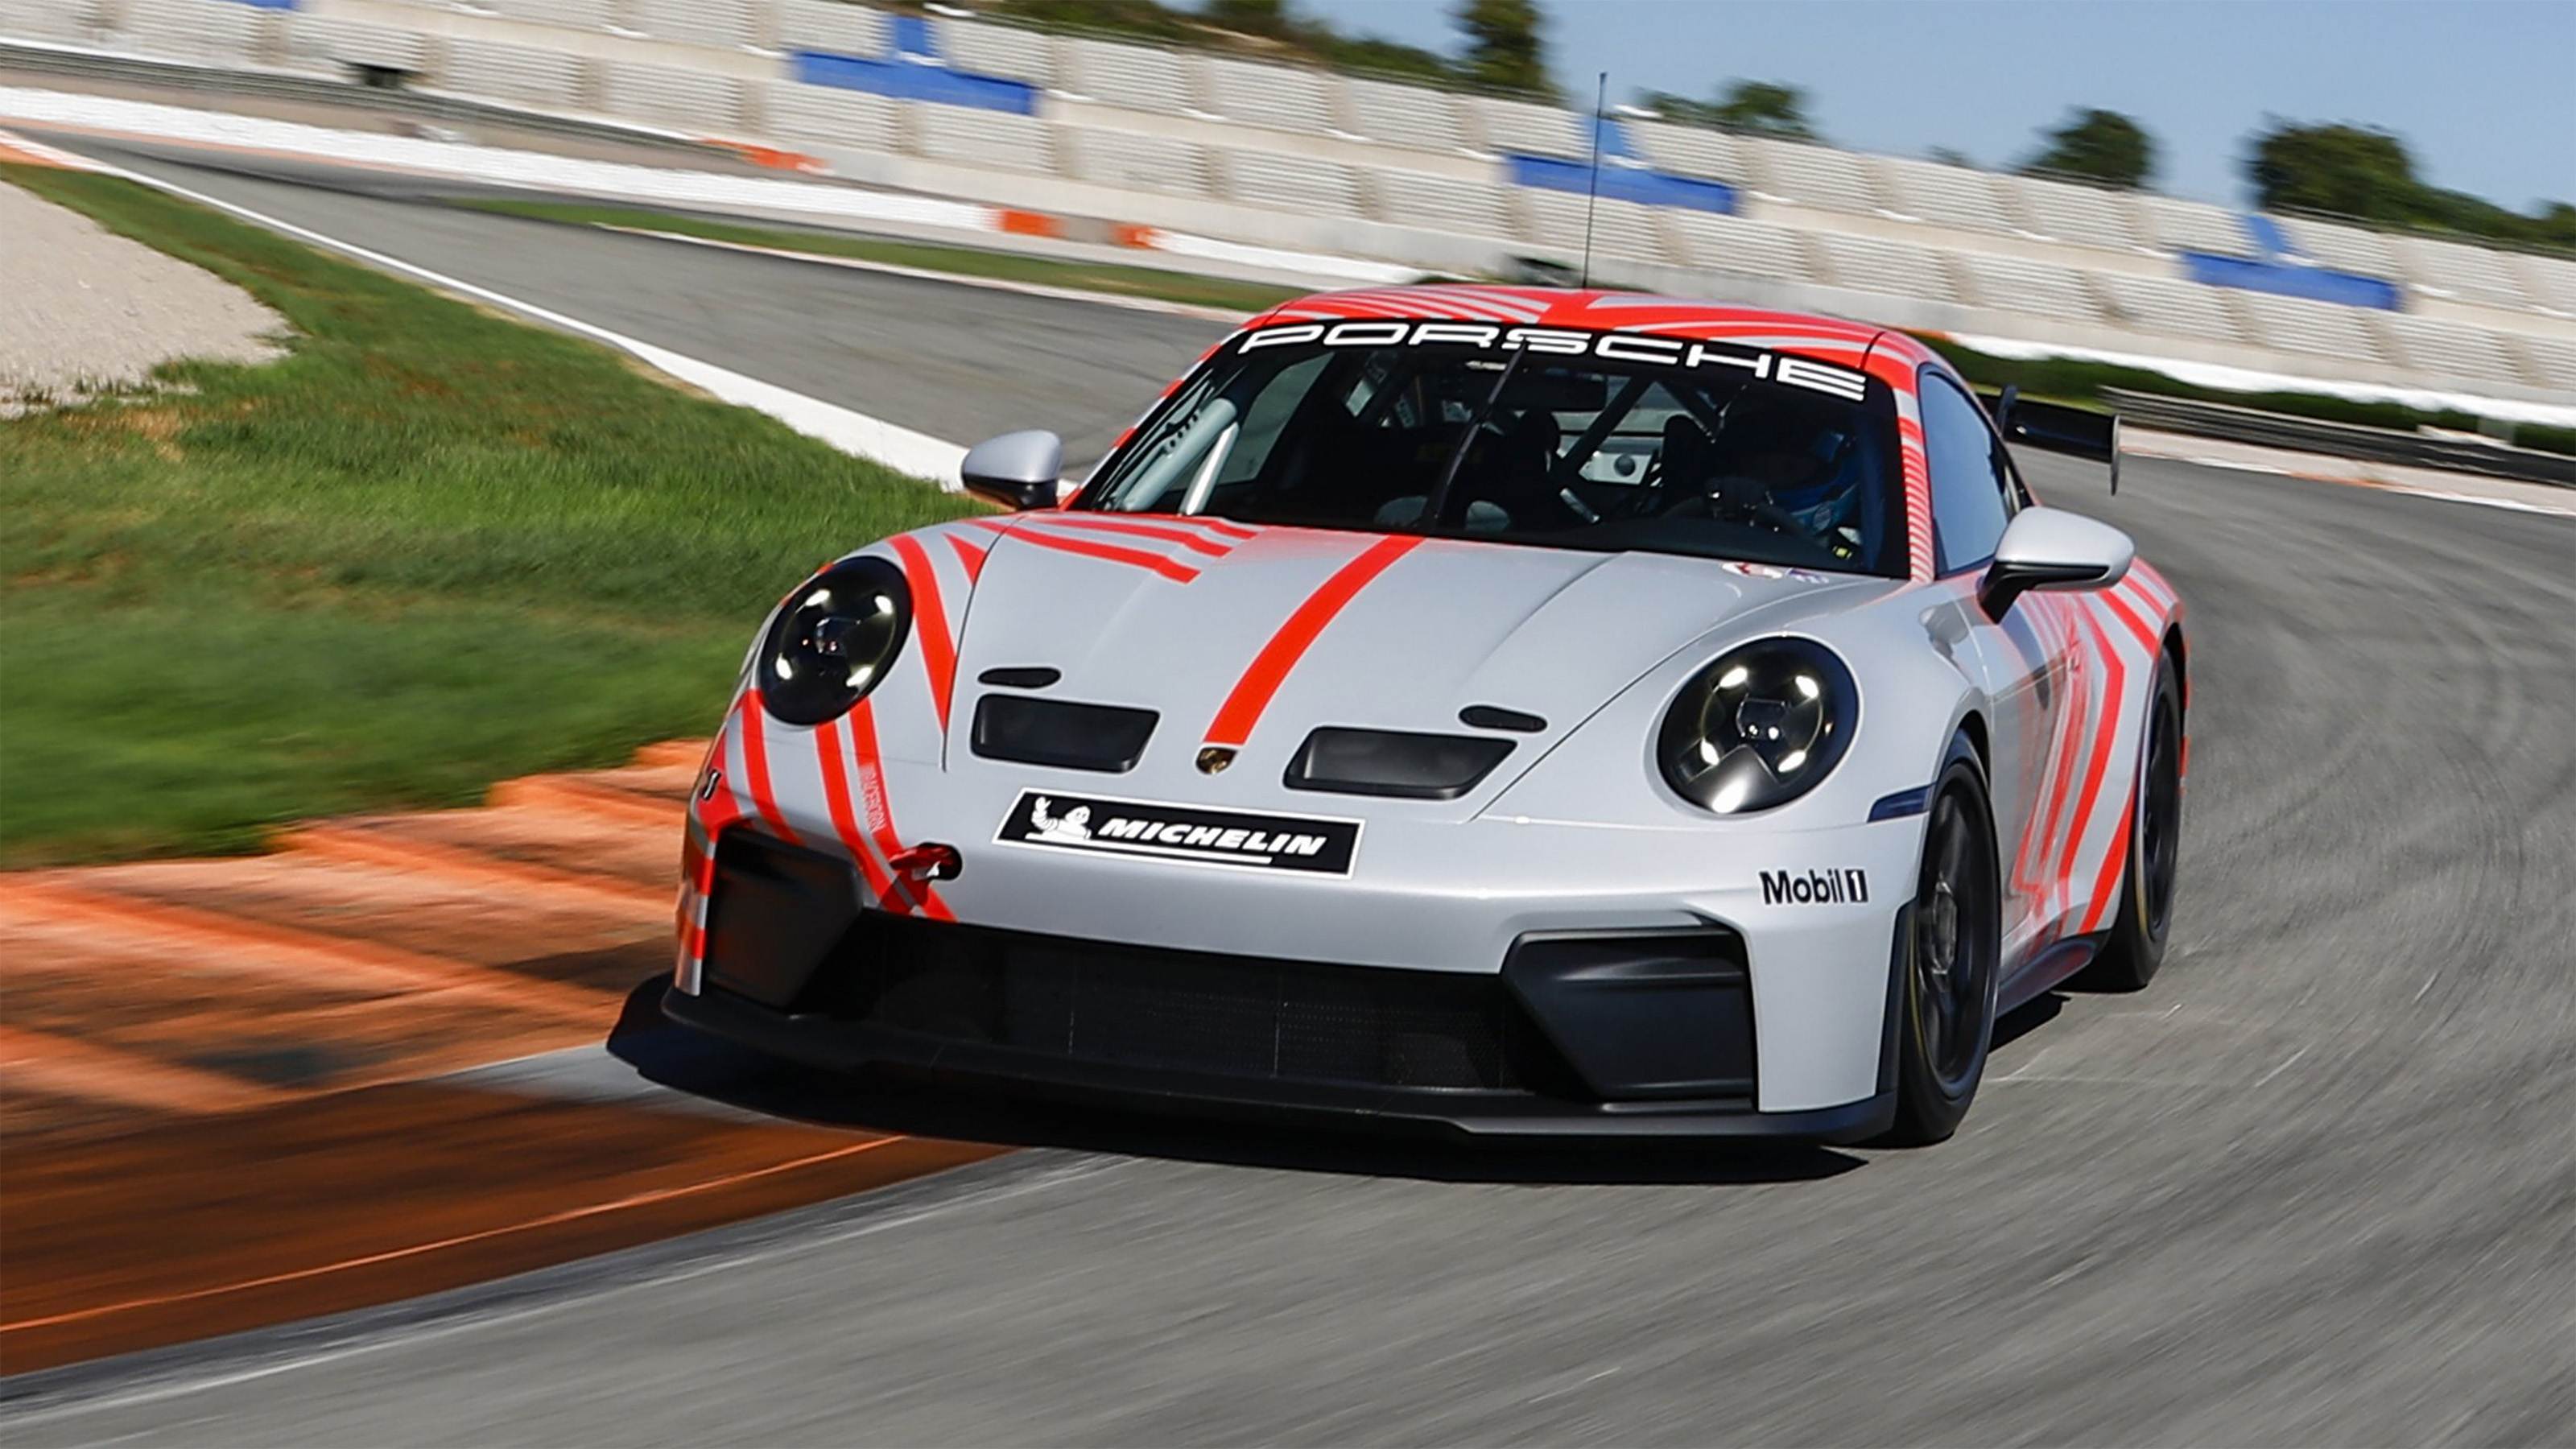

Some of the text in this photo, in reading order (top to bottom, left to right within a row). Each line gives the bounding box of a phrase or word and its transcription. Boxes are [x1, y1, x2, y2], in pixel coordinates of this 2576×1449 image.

[1238, 323, 1866, 401] PORSCHE
[1098, 818, 1327, 856] MICHELIN
[1759, 869, 1866, 905] Mobil 1
